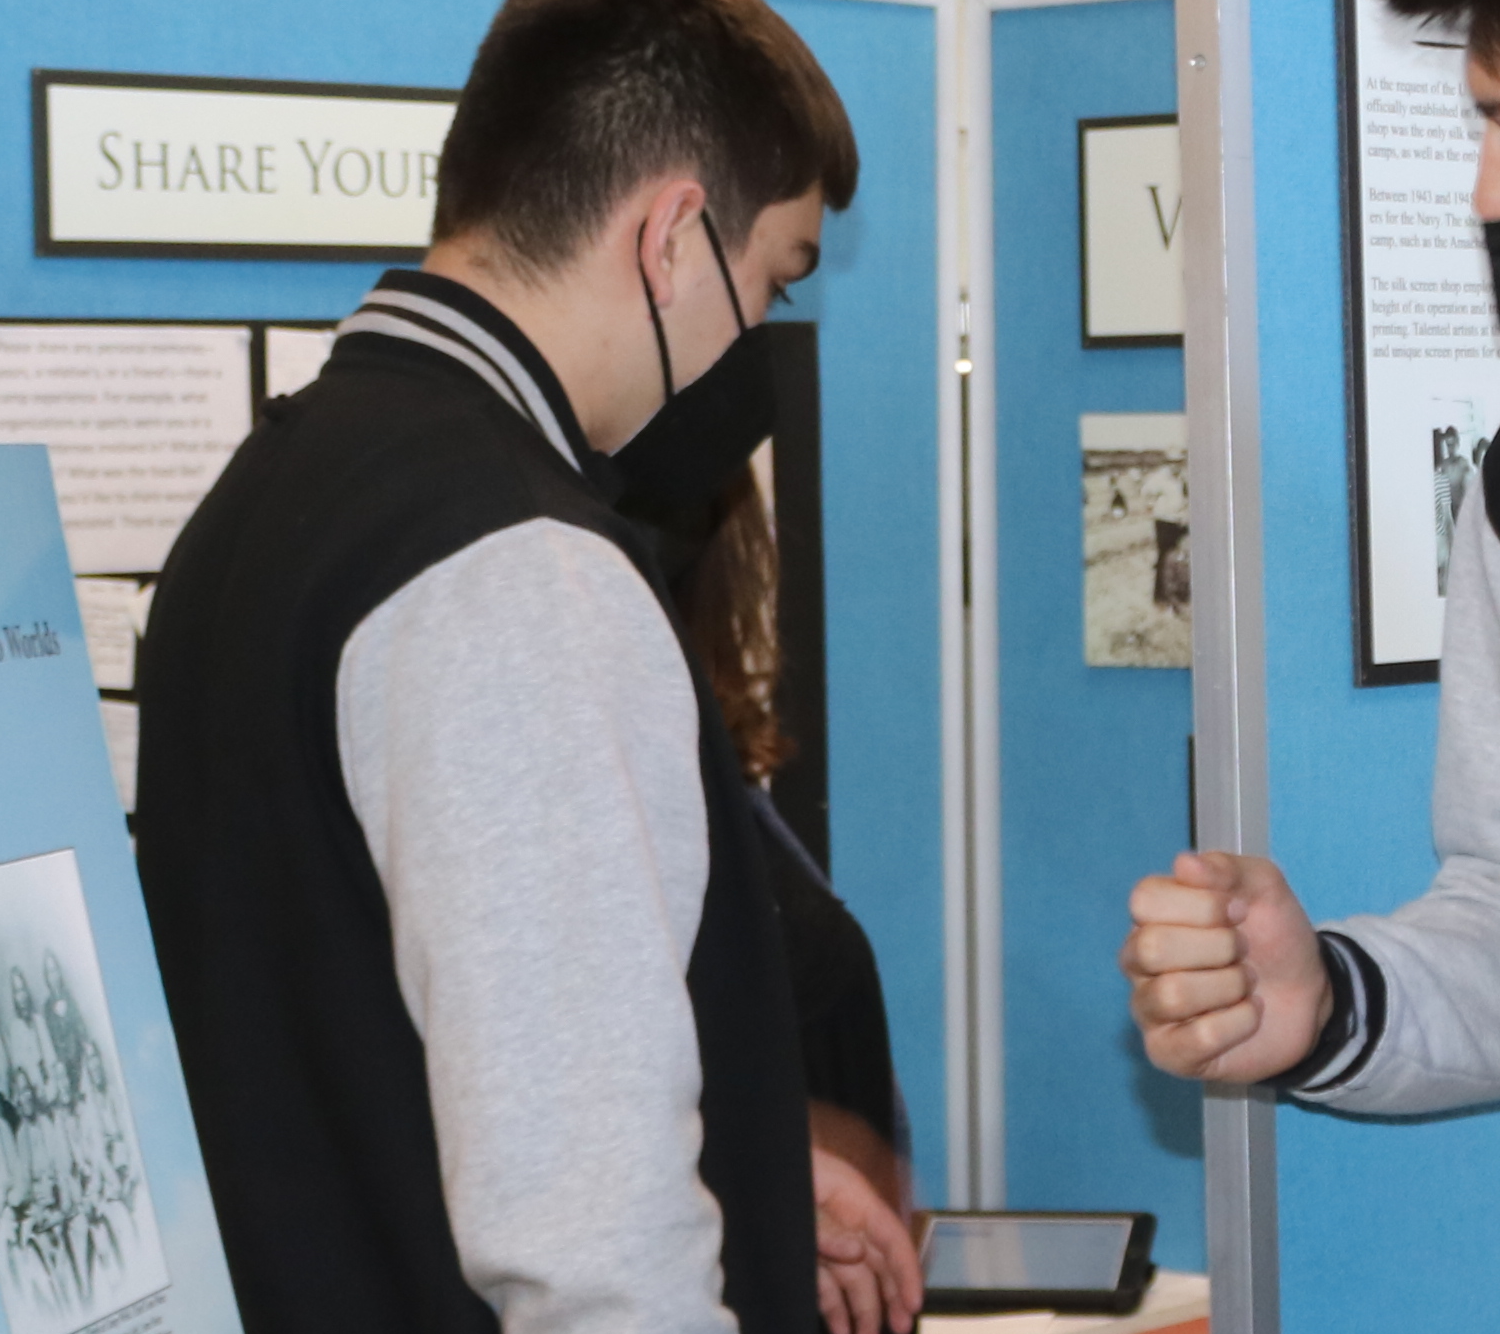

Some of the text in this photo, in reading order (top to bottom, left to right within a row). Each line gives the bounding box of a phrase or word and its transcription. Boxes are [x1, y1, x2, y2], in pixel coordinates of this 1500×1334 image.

[97, 131, 439, 199] SHARE YOUR
[1, 619, 61, 659] Worlds
